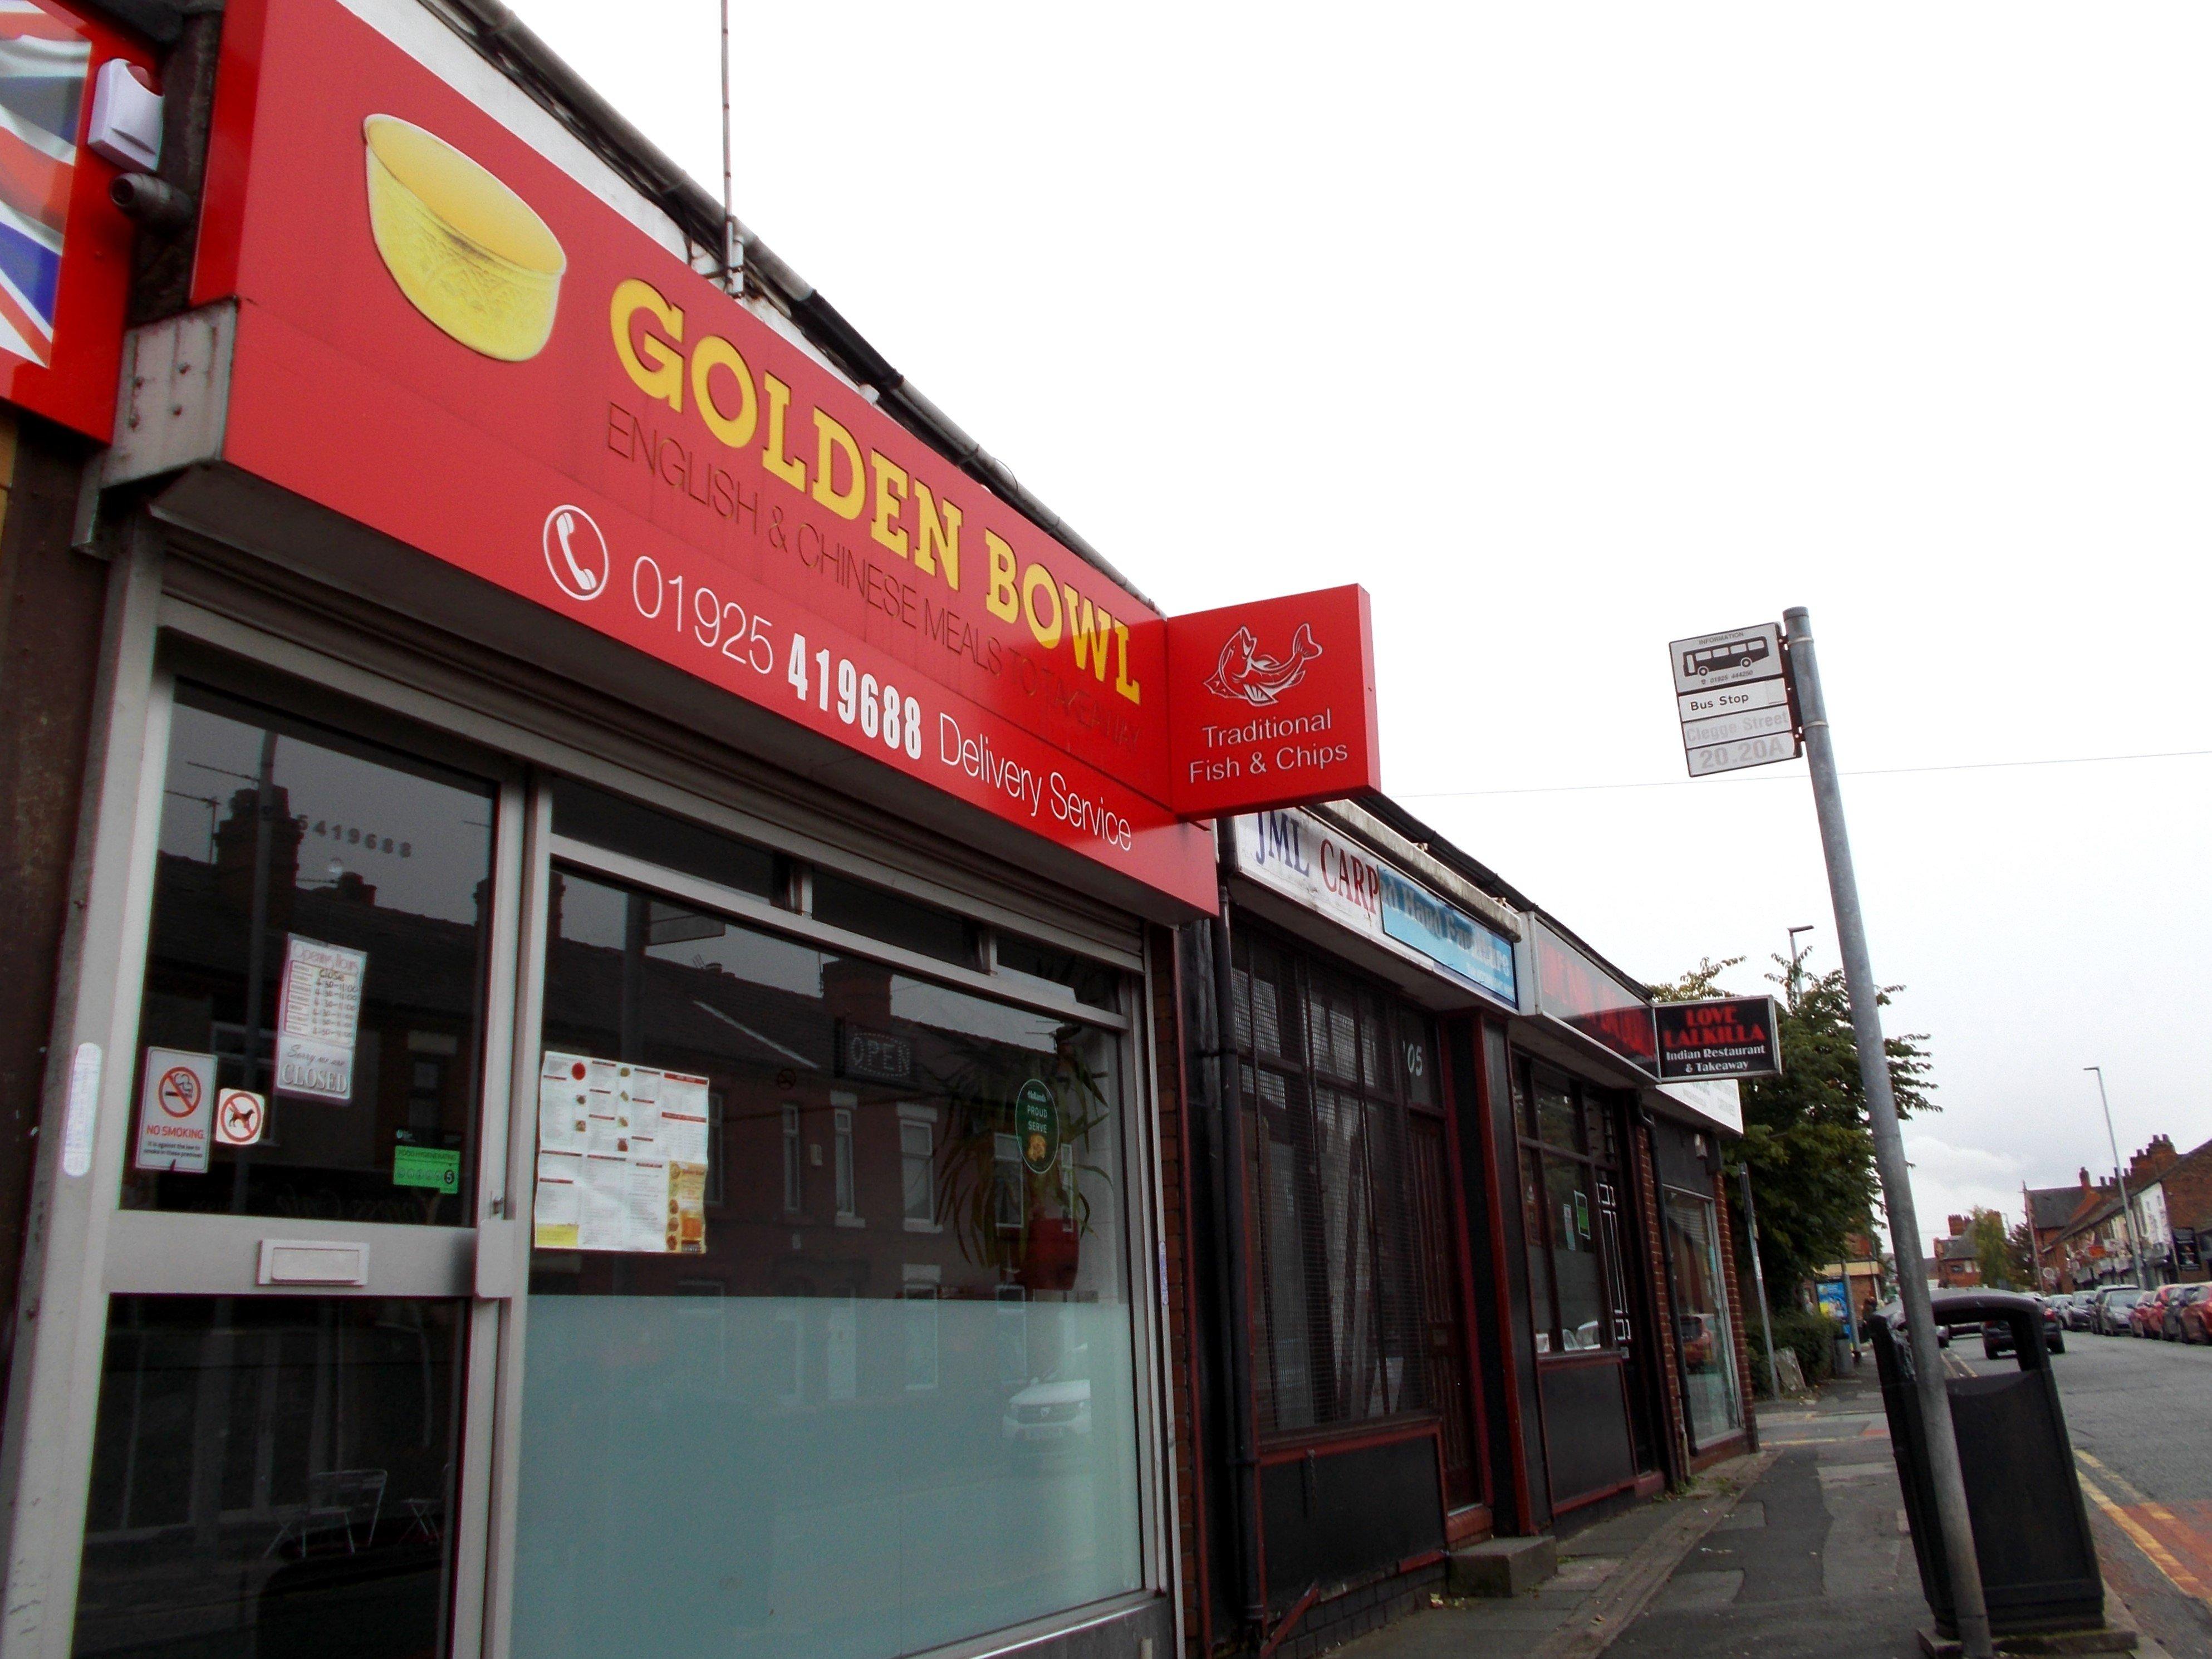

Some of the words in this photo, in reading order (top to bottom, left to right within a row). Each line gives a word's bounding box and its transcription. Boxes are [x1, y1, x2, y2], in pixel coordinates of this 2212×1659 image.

[610, 278, 964, 591] GOLDEN
[985, 528, 1141, 705] BOWL
[607, 402, 759, 534] ENGLISH
[768, 506, 788, 553] &
[798, 523, 917, 630] CHINESE
[924, 598, 1002, 678] MEALS
[1699, 631, 1744, 645] INFORMATION
[633, 556, 773, 675] 01925
[788, 632, 921, 760] 419688
[939, 712, 1042, 817] Delivery
[1050, 772, 1132, 852] Service
[1690, 701, 1714, 711] Bus
[1719, 694, 1749, 706] Stop
[1201, 708, 1332, 748] Traditional
[1743, 711, 1789, 730] Street
[1189, 756, 1240, 784] Fish
[1249, 752, 1267, 774] &
[1276, 743, 1348, 770] Chips
[1255, 810, 1309, 877] JML
[1686, 1004, 1738, 1027] LOVE
[849, 1036, 910, 1074] OPEN
[1666, 1049, 1701, 1061] Indian
[1703, 1044, 1765, 1058] Restaurant
[282, 1063, 348, 1093] CLOSED
[1685, 1063, 1693, 1073] &
[1695, 1060, 1749, 1072] Takeaway
[1027, 1105, 1048, 1118] PROUD
[146, 1125, 160, 1135] NO
[1028, 1120, 1048, 1133] SERVE
